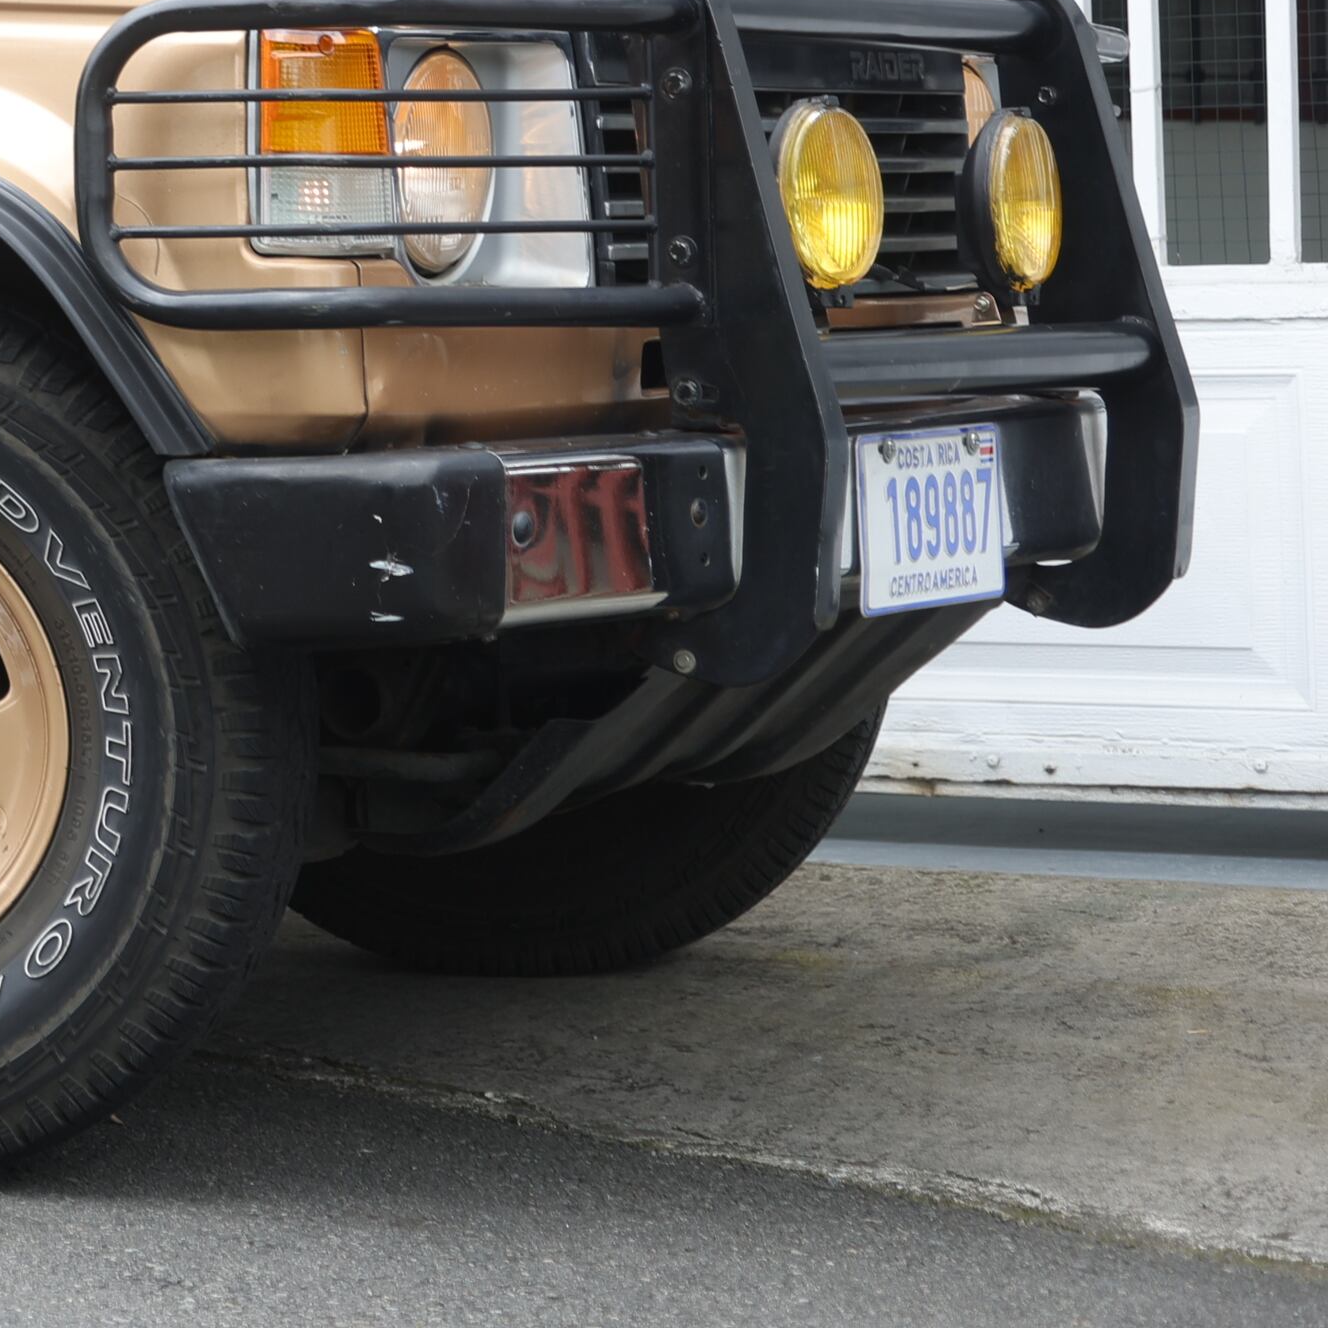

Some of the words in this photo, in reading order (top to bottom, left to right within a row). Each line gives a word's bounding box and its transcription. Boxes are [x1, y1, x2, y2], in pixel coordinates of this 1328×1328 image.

[850, 50, 926, 81] RAIDER
[897, 445, 934, 470] COSTA
[938, 441, 961, 464] RICA
[886, 468, 993, 565] 189887
[889, 566, 978, 598] CENTROAMERICA
